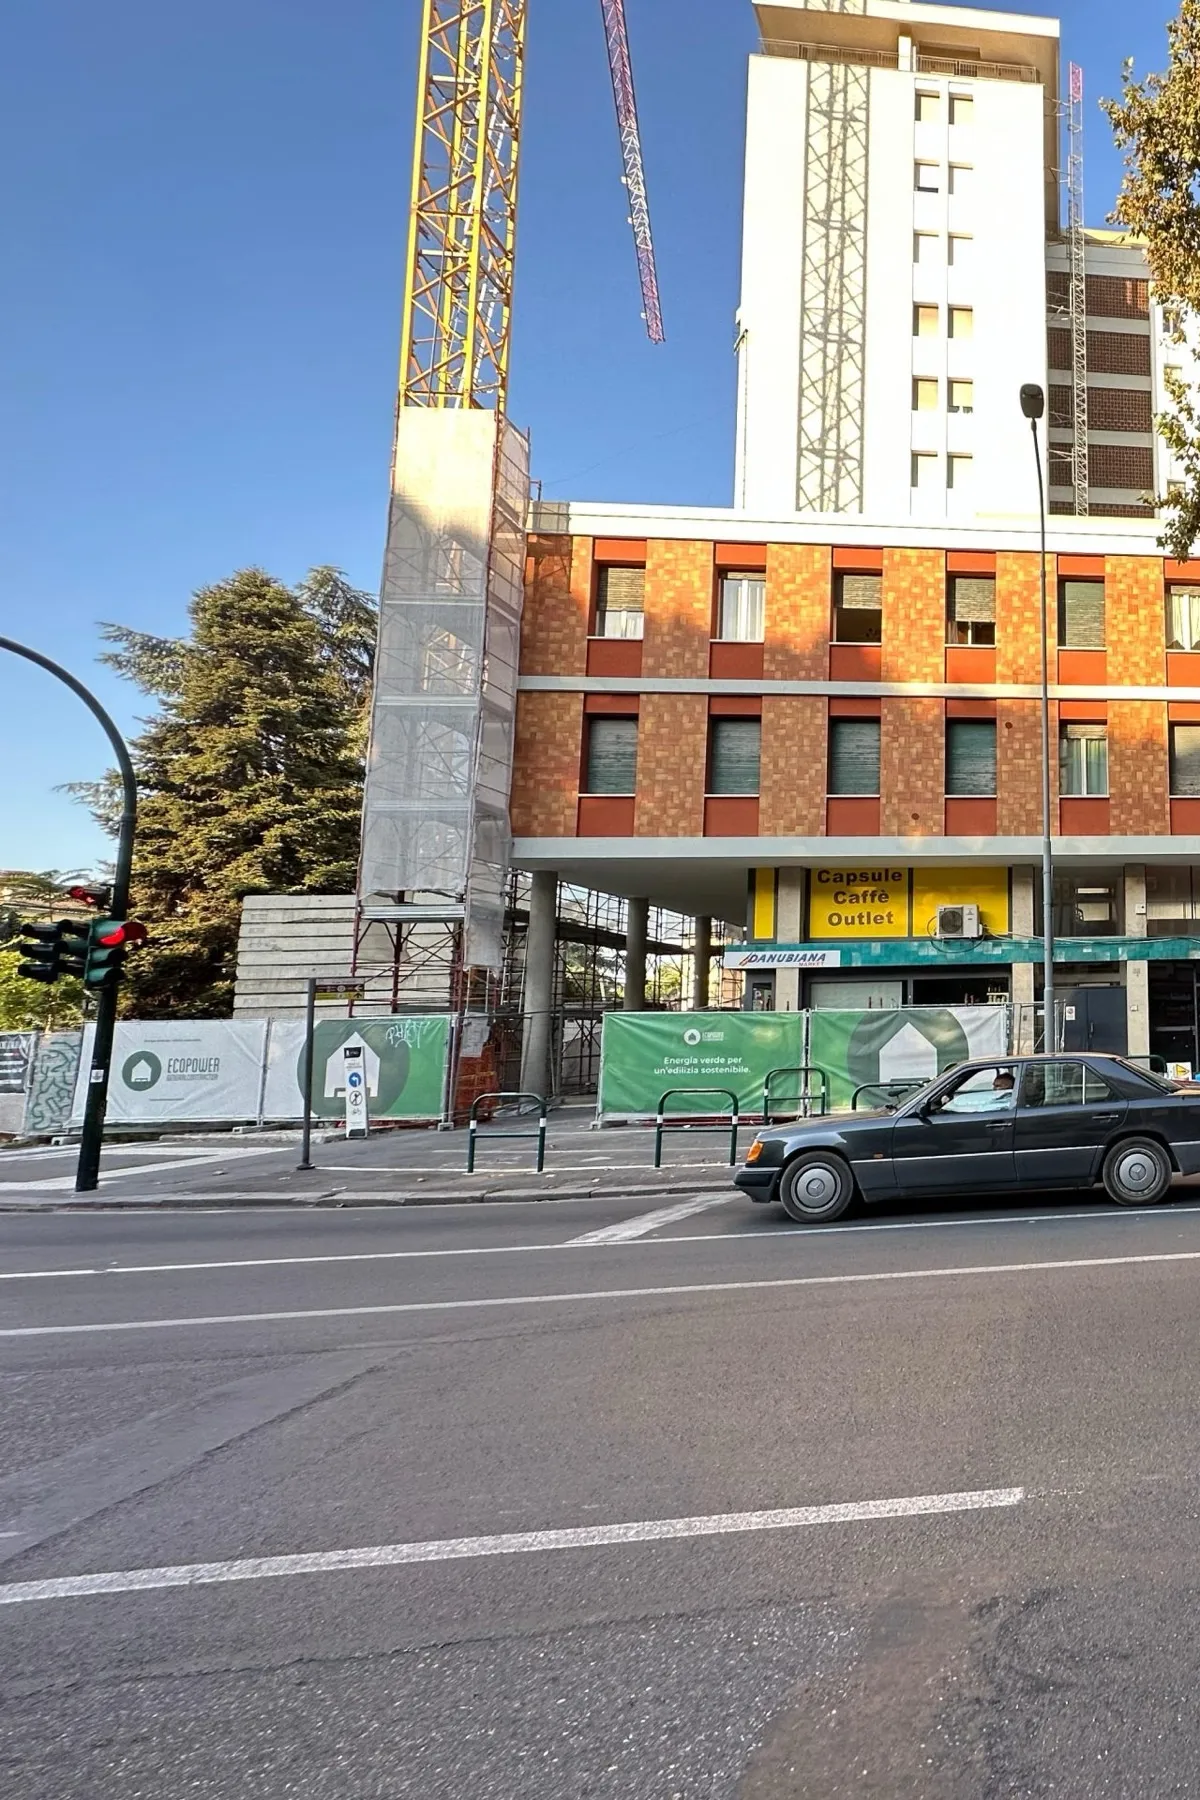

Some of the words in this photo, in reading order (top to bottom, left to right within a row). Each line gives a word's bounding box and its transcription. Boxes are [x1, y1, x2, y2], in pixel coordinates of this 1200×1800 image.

[817, 868, 903, 886] Capsule
[833, 889, 890, 905] Caffè
[828, 911, 894, 926] Outlet
[748, 952, 827, 963] DANUBIANA
[167, 1057, 220, 1073] ECOPOWER
[663, 1056, 698, 1066] Energia
[700, 1056, 725, 1064] verde
[727, 1057, 742, 1066] per
[654, 1066, 699, 1074] un'edilizia
[700, 1065, 751, 1074] sostenibile.
